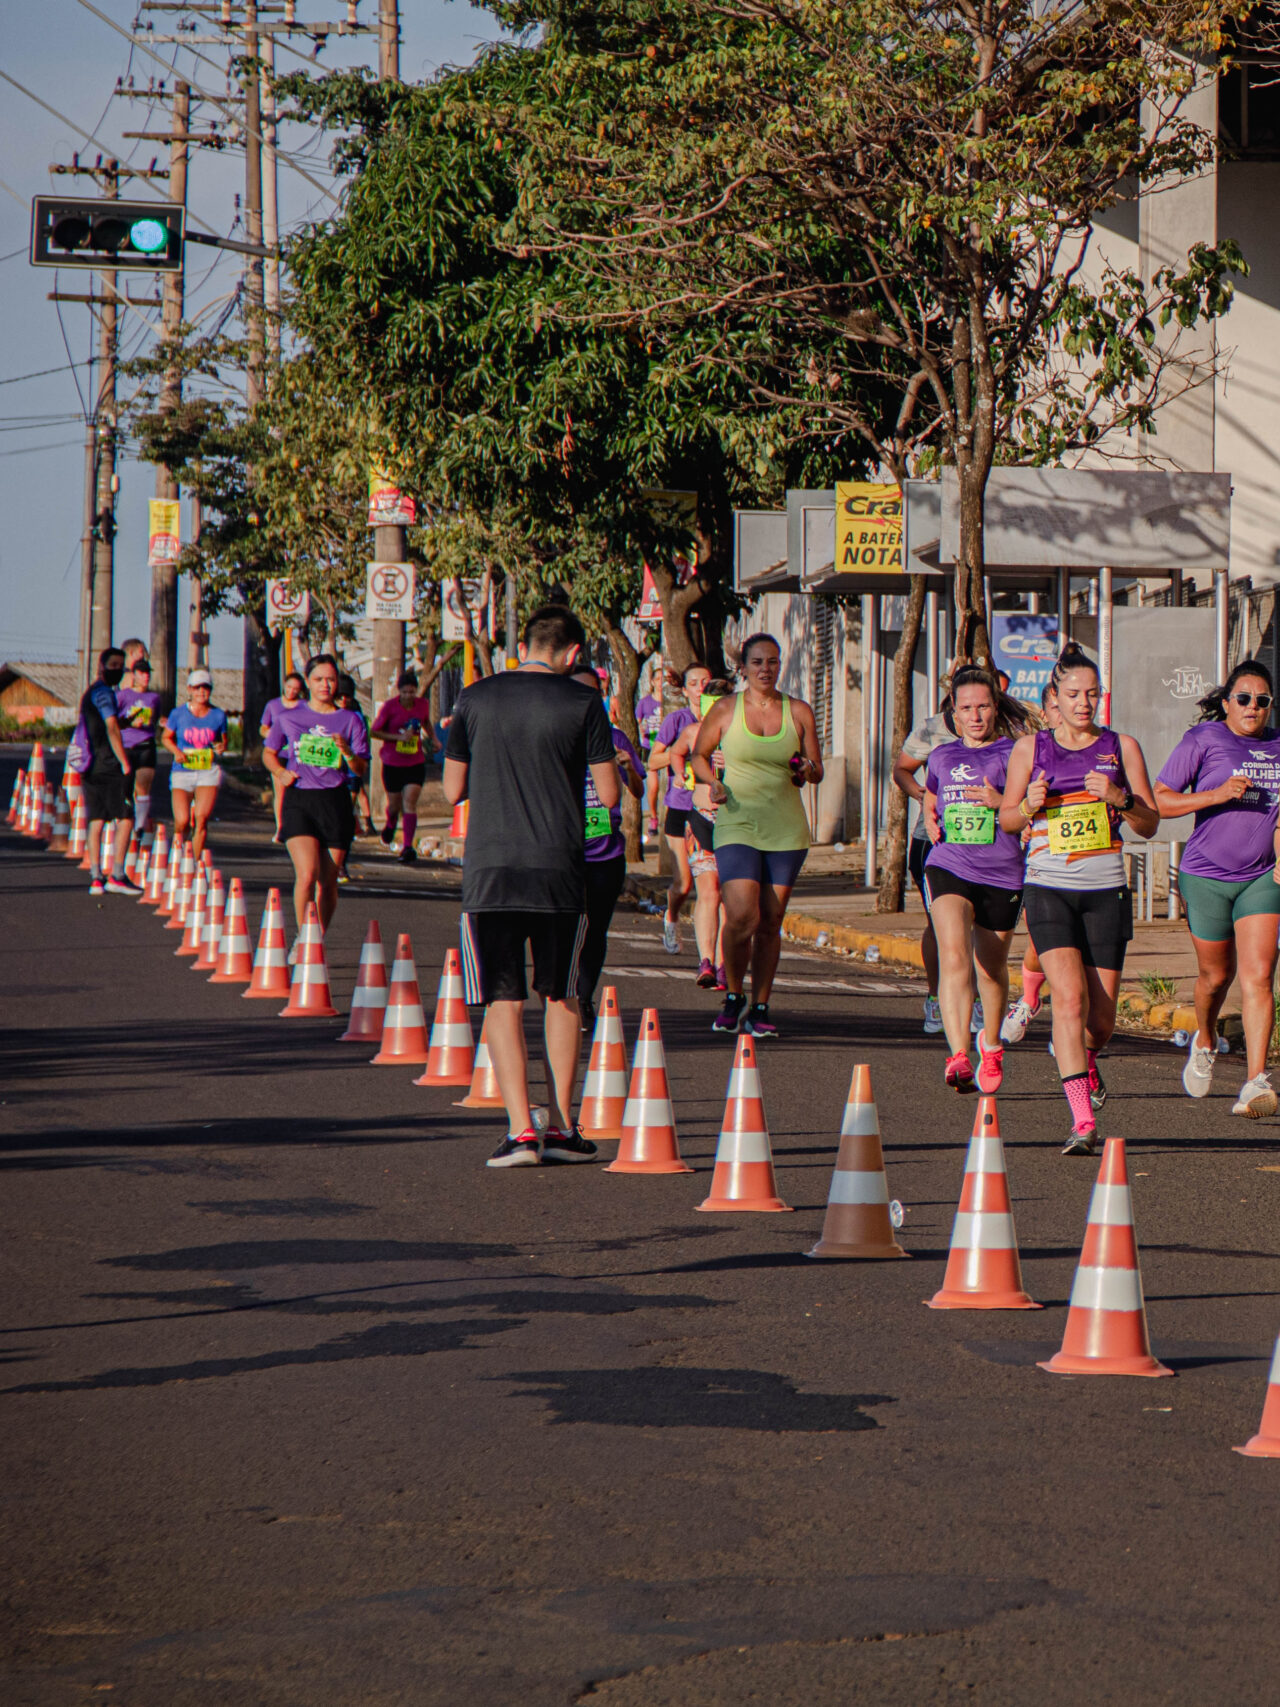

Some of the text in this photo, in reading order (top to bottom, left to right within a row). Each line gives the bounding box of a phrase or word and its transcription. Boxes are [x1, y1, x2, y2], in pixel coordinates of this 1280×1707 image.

[843, 495, 904, 516] Cra
[843, 531, 855, 545] A
[843, 547, 903, 566] NOTA
[307, 744, 333, 759] 446
[1242, 761, 1274, 769] CORRIDA
[954, 817, 987, 831] 557
[1060, 818, 1098, 838] 824
